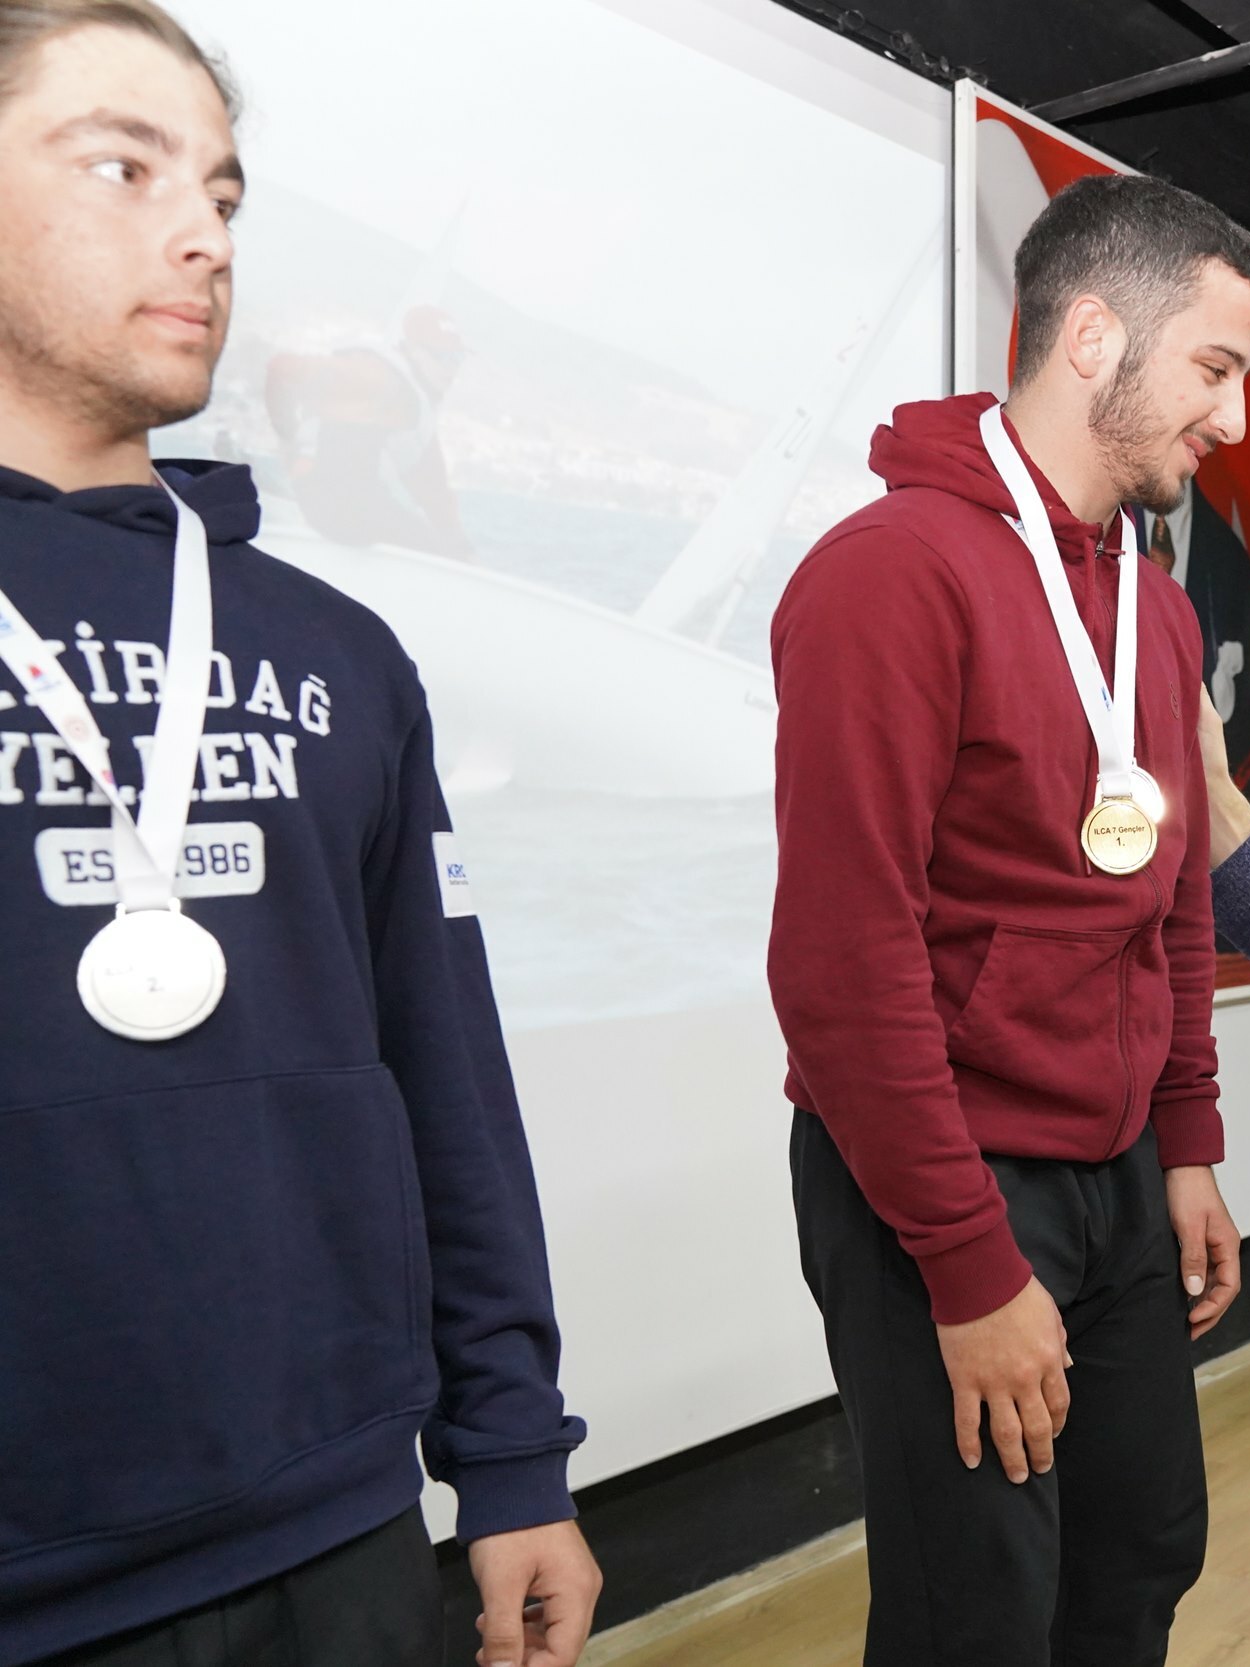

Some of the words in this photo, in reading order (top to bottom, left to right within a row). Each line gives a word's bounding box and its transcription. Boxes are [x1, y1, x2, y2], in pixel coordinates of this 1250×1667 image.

[1118, 825, 1145, 834] Gençler
[1116, 836, 1126, 847] 1.
[61, 849, 115, 884] ES
[174, 842, 250, 878] 986
